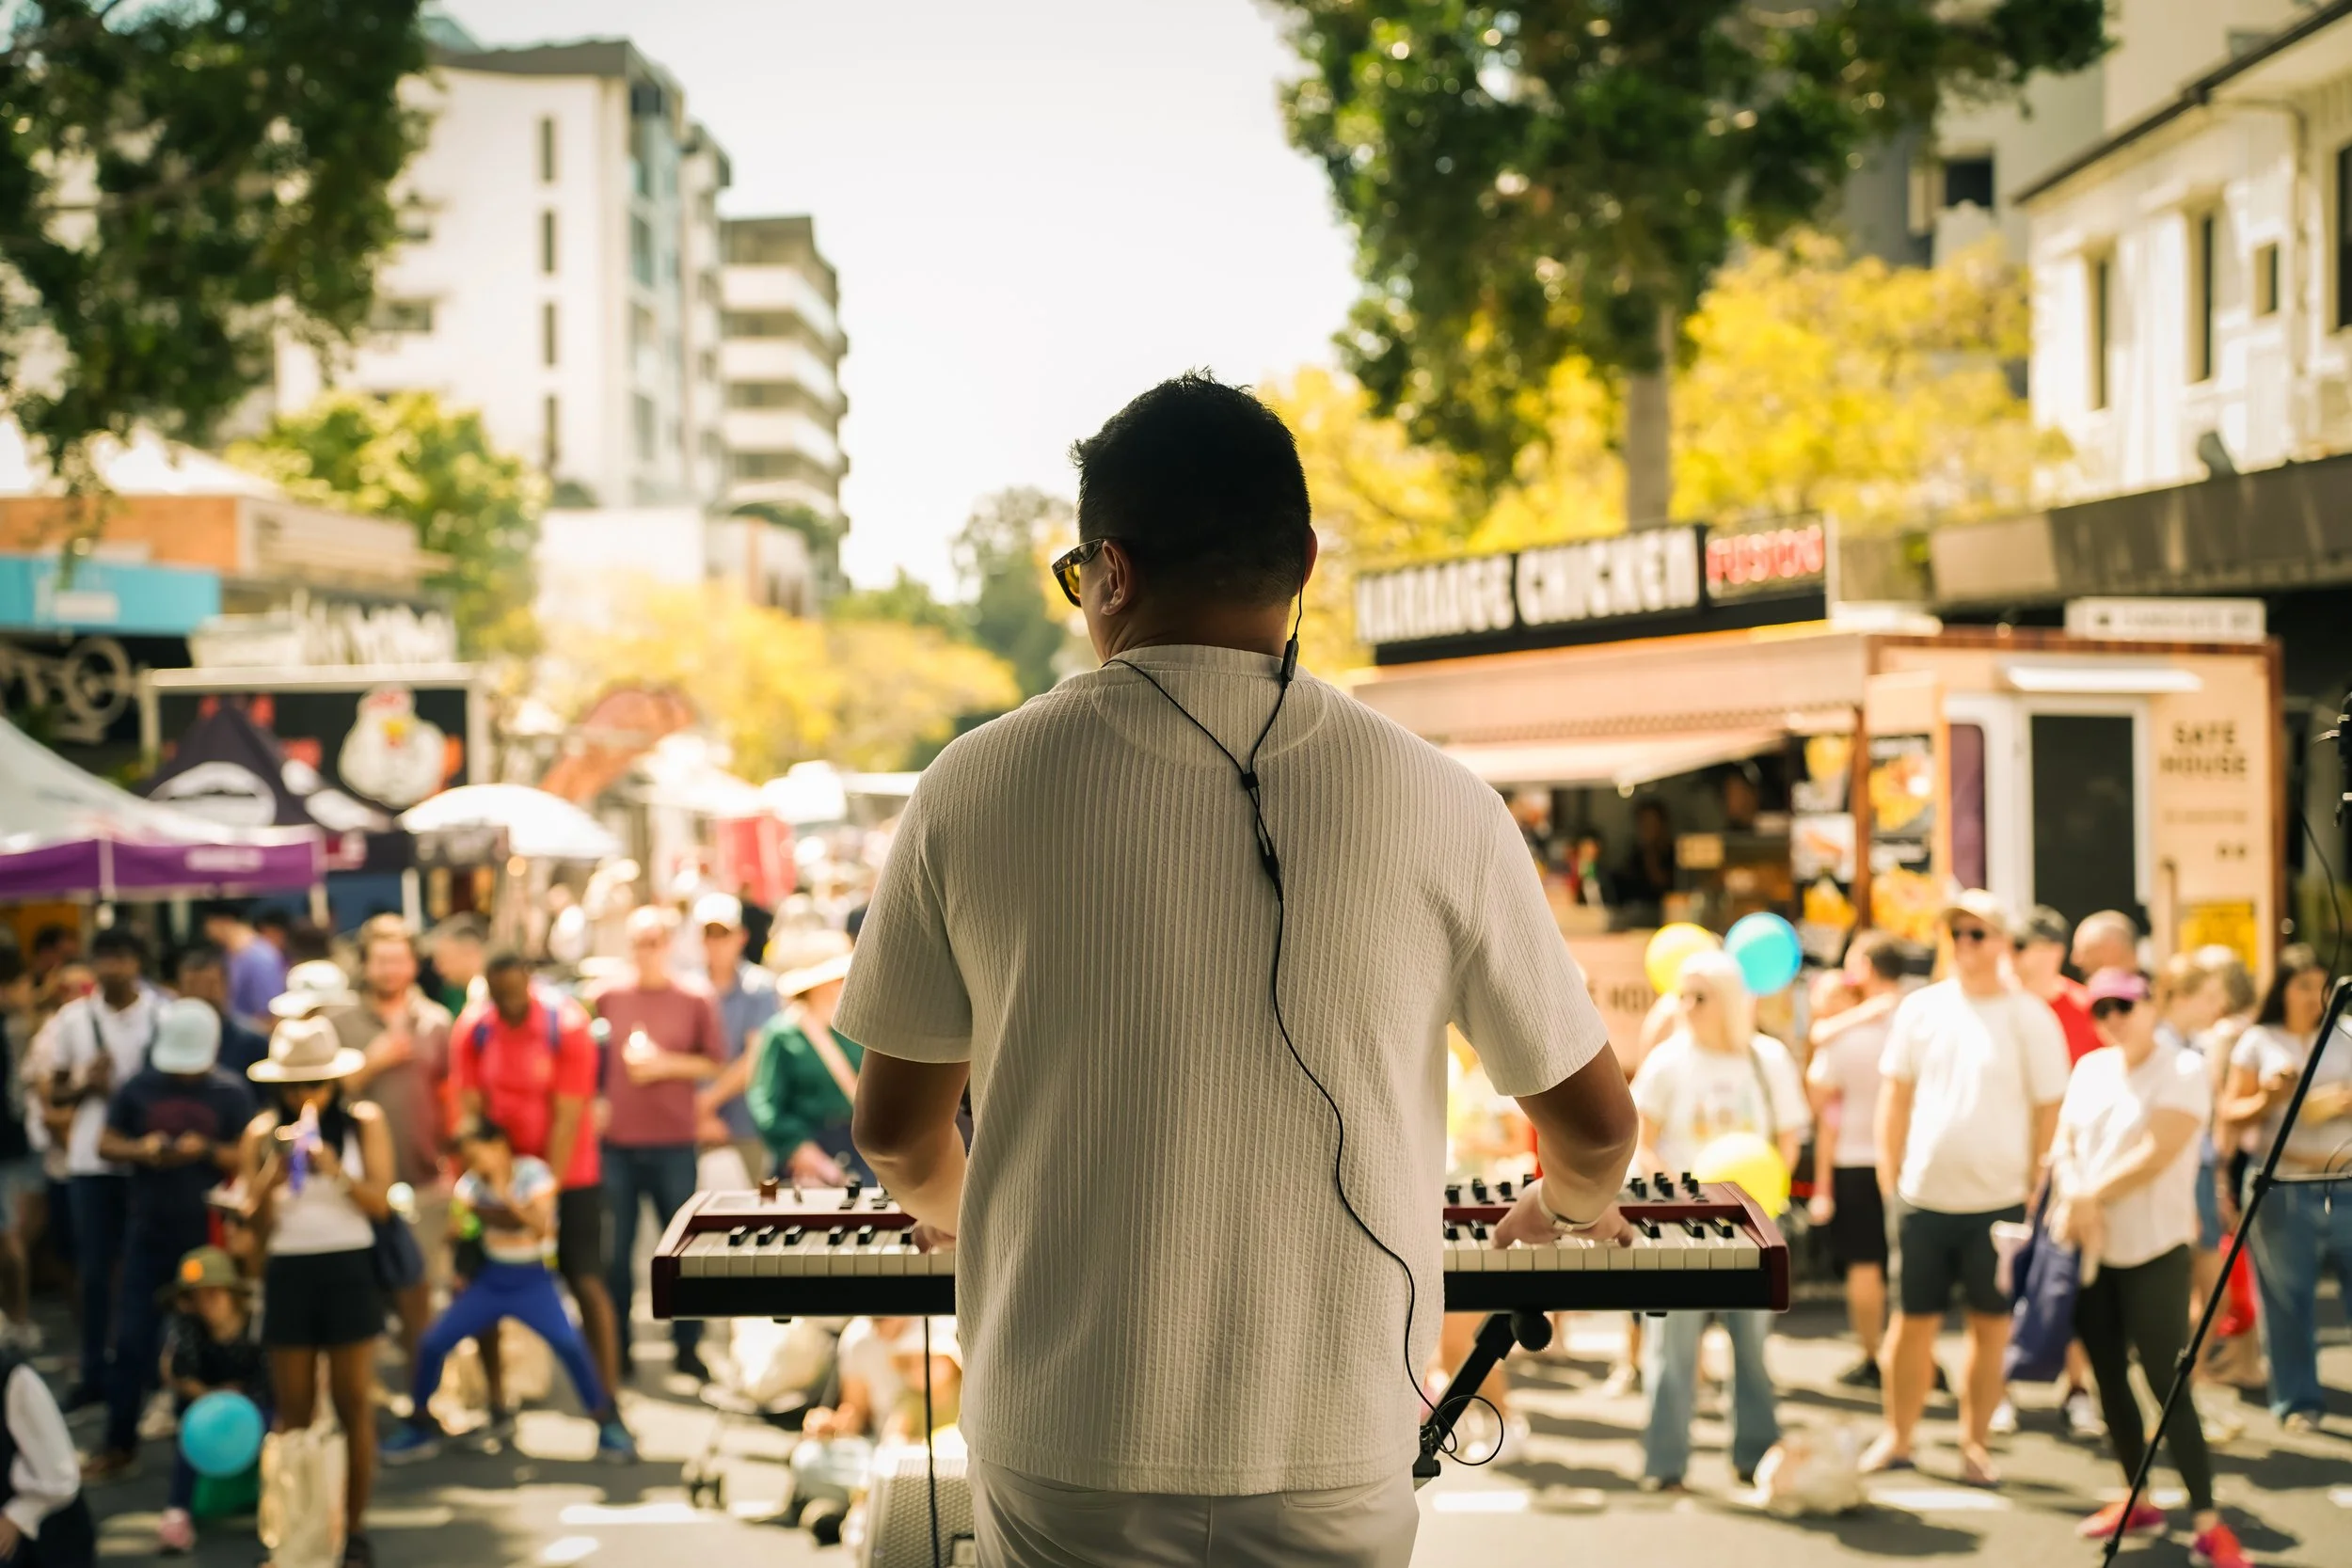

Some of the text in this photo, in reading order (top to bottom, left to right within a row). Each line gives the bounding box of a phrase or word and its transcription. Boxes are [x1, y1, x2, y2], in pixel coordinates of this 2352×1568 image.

[1517, 527, 1698, 625] CHICKEN
[1707, 524, 1824, 597] FUSION
[2159, 754, 2246, 781] HOUSE
